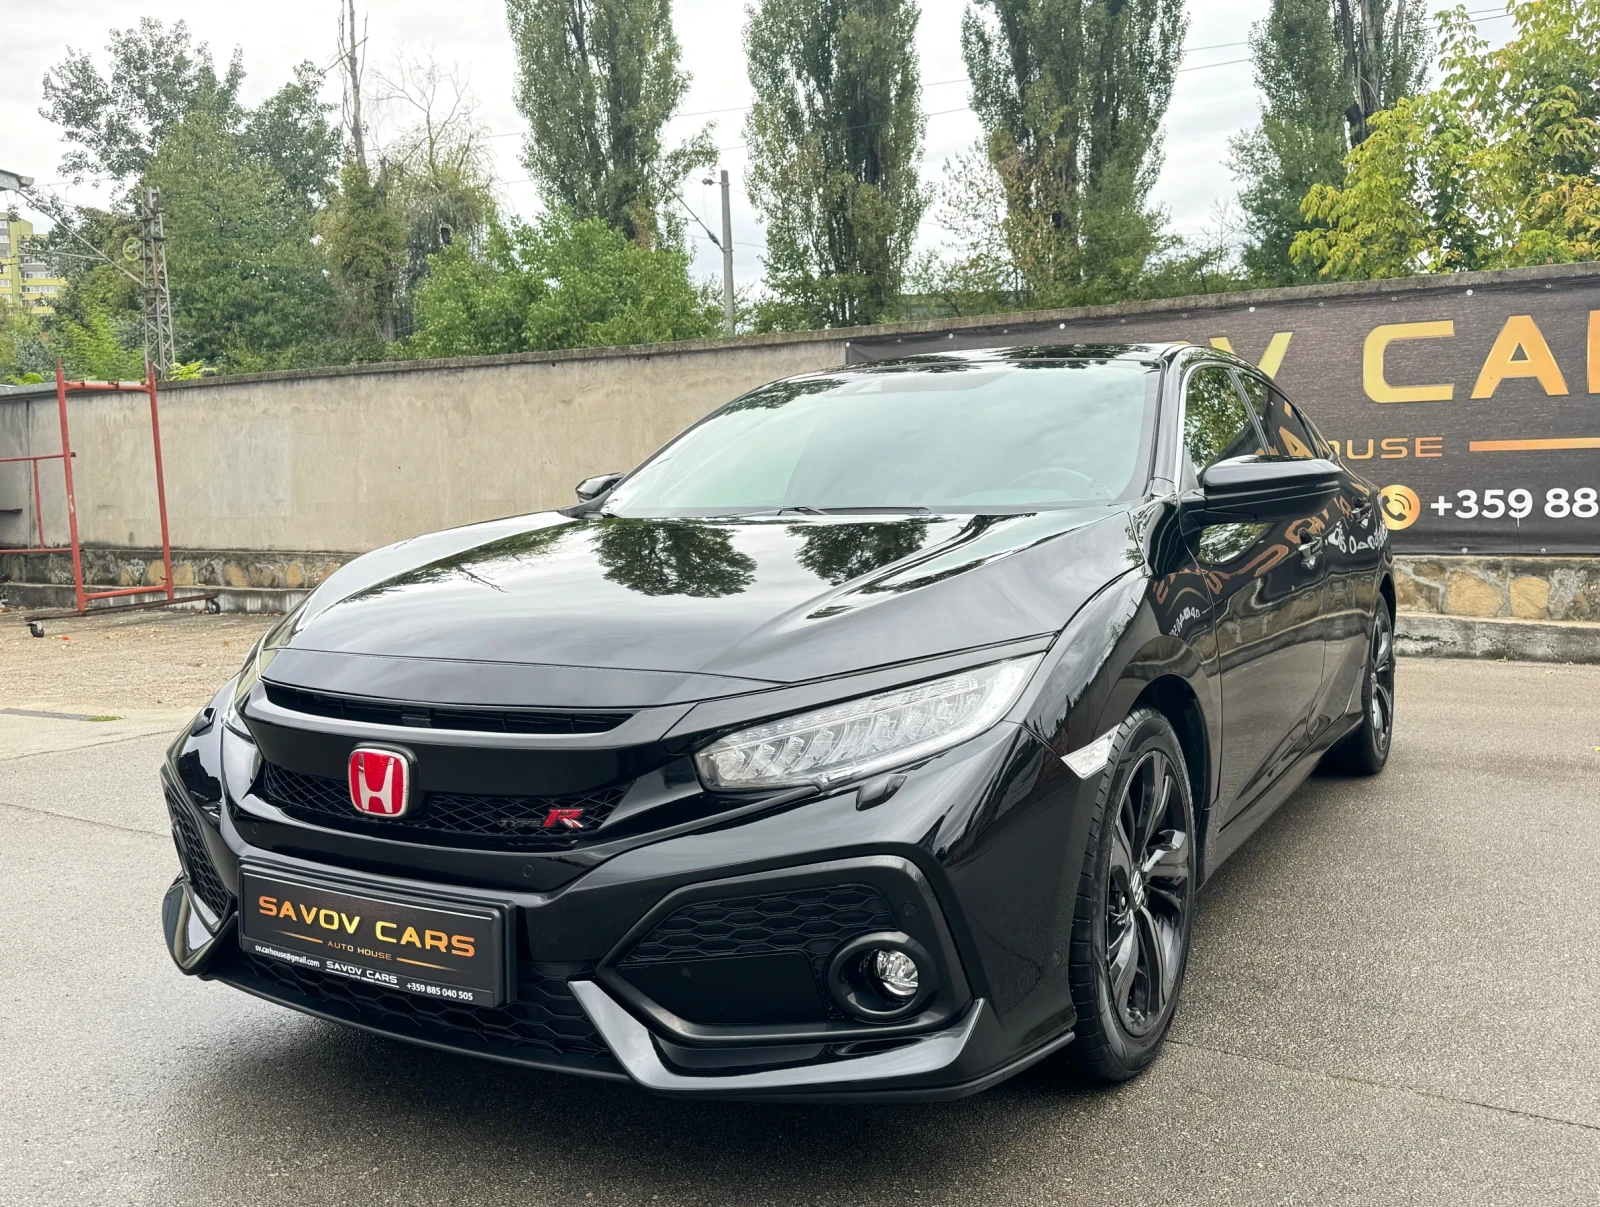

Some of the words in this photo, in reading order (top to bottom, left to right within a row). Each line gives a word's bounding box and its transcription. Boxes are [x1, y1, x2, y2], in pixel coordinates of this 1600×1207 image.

[1363, 310, 1600, 404] CA
[1430, 488, 1533, 519] +359
[1544, 487, 1599, 518] 88
[258, 895, 361, 934] SAVOV
[375, 920, 476, 958] CARS
[254, 944, 320, 968] sv.carhouse@gmail.com
[327, 940, 354, 952] AUTO
[357, 947, 393, 960] HOUSE
[326, 961, 363, 975] SAVOV
[366, 970, 398, 984] CARS
[406, 982, 426, 993] +359
[426, 985, 441, 996] 885
[442, 988, 457, 998] 040
[458, 991, 474, 1001] 505
